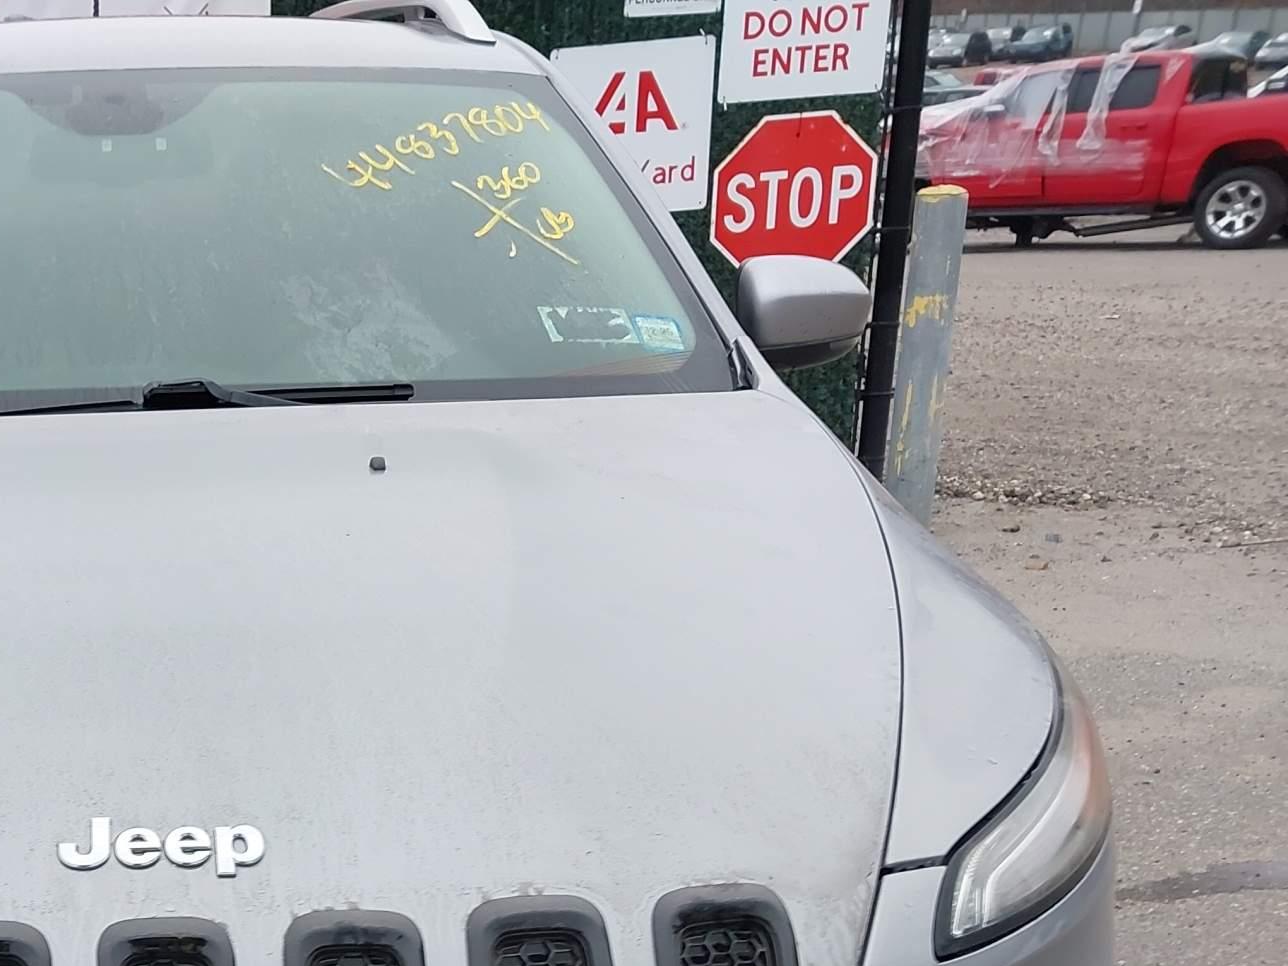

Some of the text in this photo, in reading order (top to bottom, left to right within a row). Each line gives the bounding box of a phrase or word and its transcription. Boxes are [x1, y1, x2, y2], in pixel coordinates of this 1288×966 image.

[743, 2, 870, 40] DO NOT
[752, 43, 850, 77] ENTER
[641, 155, 695, 184] ard
[723, 164, 863, 233] STOP
[56, 816, 265, 878] Jeep
